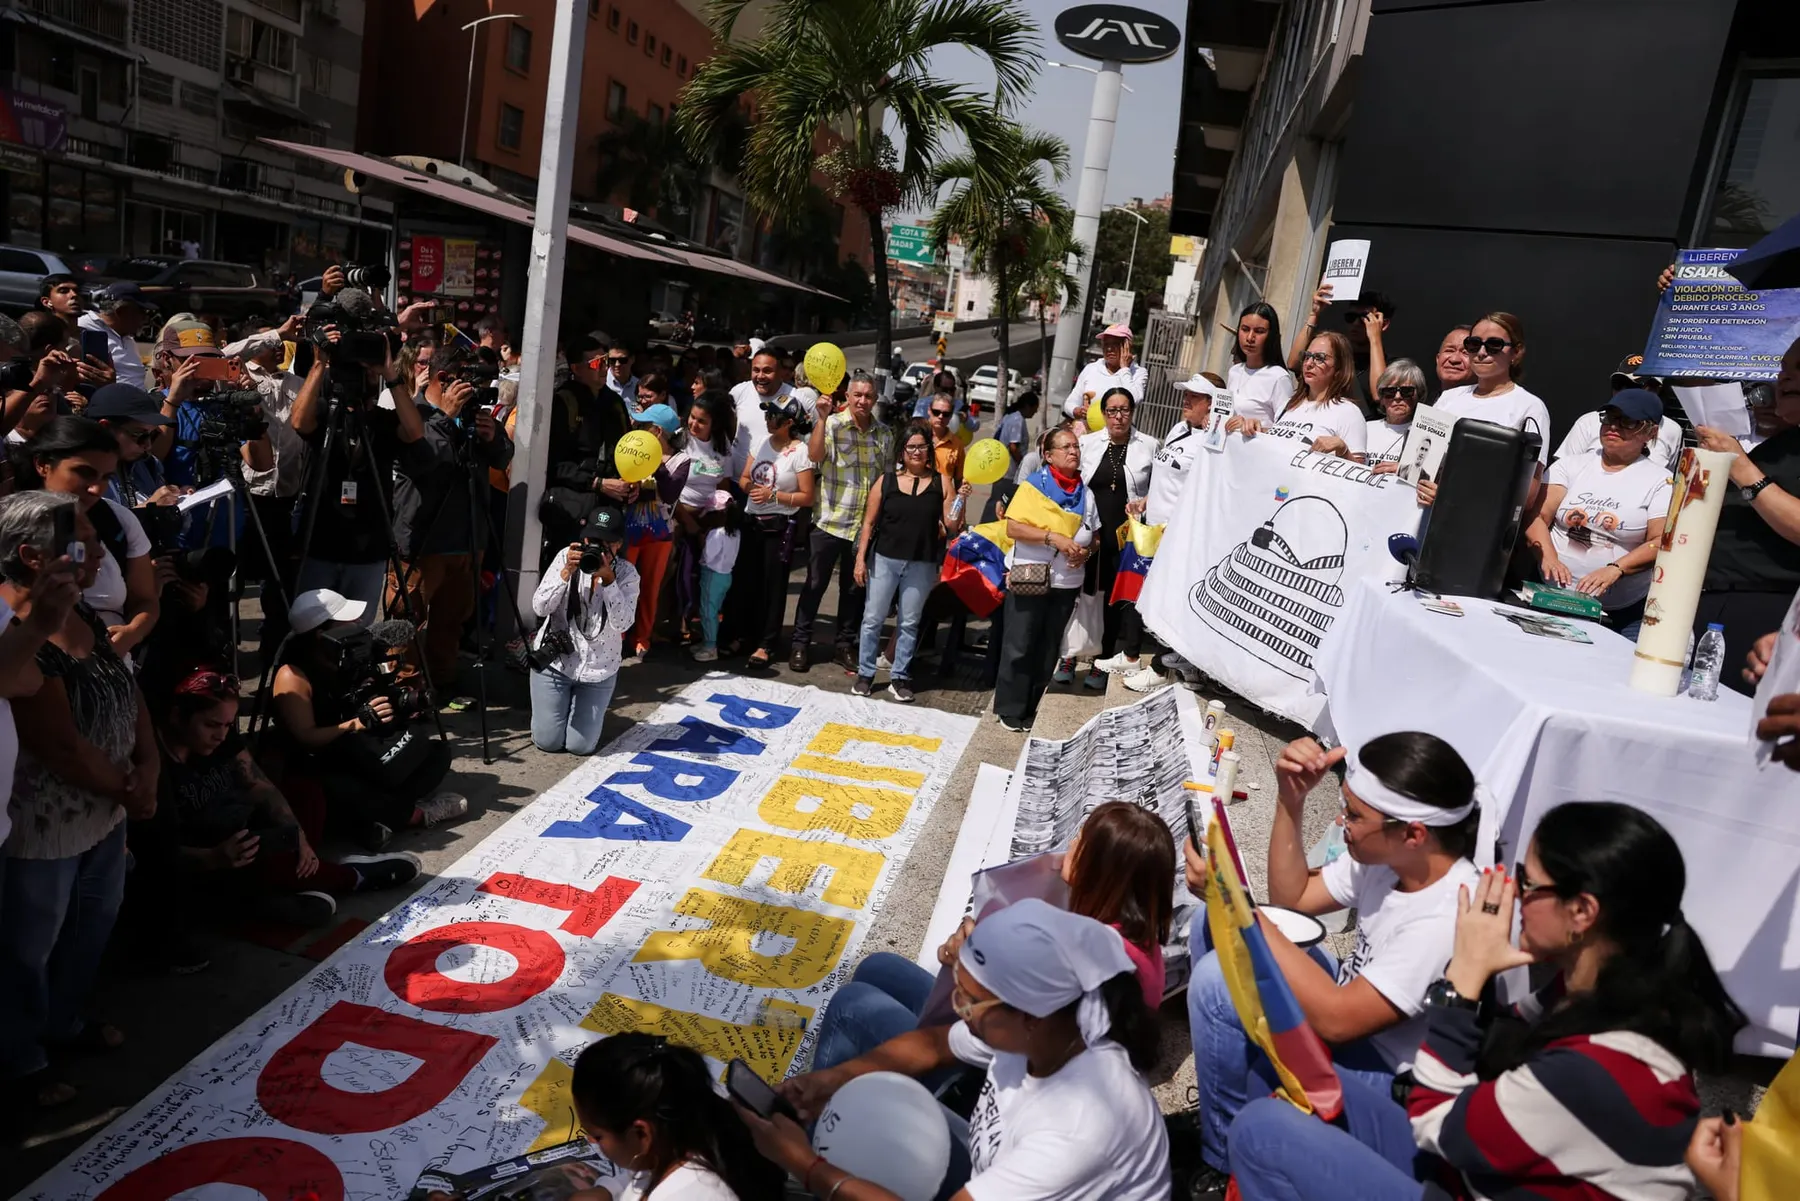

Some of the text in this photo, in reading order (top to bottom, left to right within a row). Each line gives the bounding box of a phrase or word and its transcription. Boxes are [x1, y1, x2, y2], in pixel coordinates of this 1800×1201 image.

[900, 228, 918, 236] COTA
[890, 240, 914, 250] MADAS
[1689, 252, 1738, 262] LIBEREN
[1356, 259, 1362, 268] A
[1674, 284, 1724, 292] VIOLACIÓN
[1674, 294, 1758, 302] DEBIDO PROCESO
[1672, 370, 1746, 378] LIBERTAD
[1570, 492, 1620, 509] Santos
[1678, 534, 1688, 545] 5
[538, 692, 802, 842] PARA
[478, 1062, 536, 1116] Seremos
